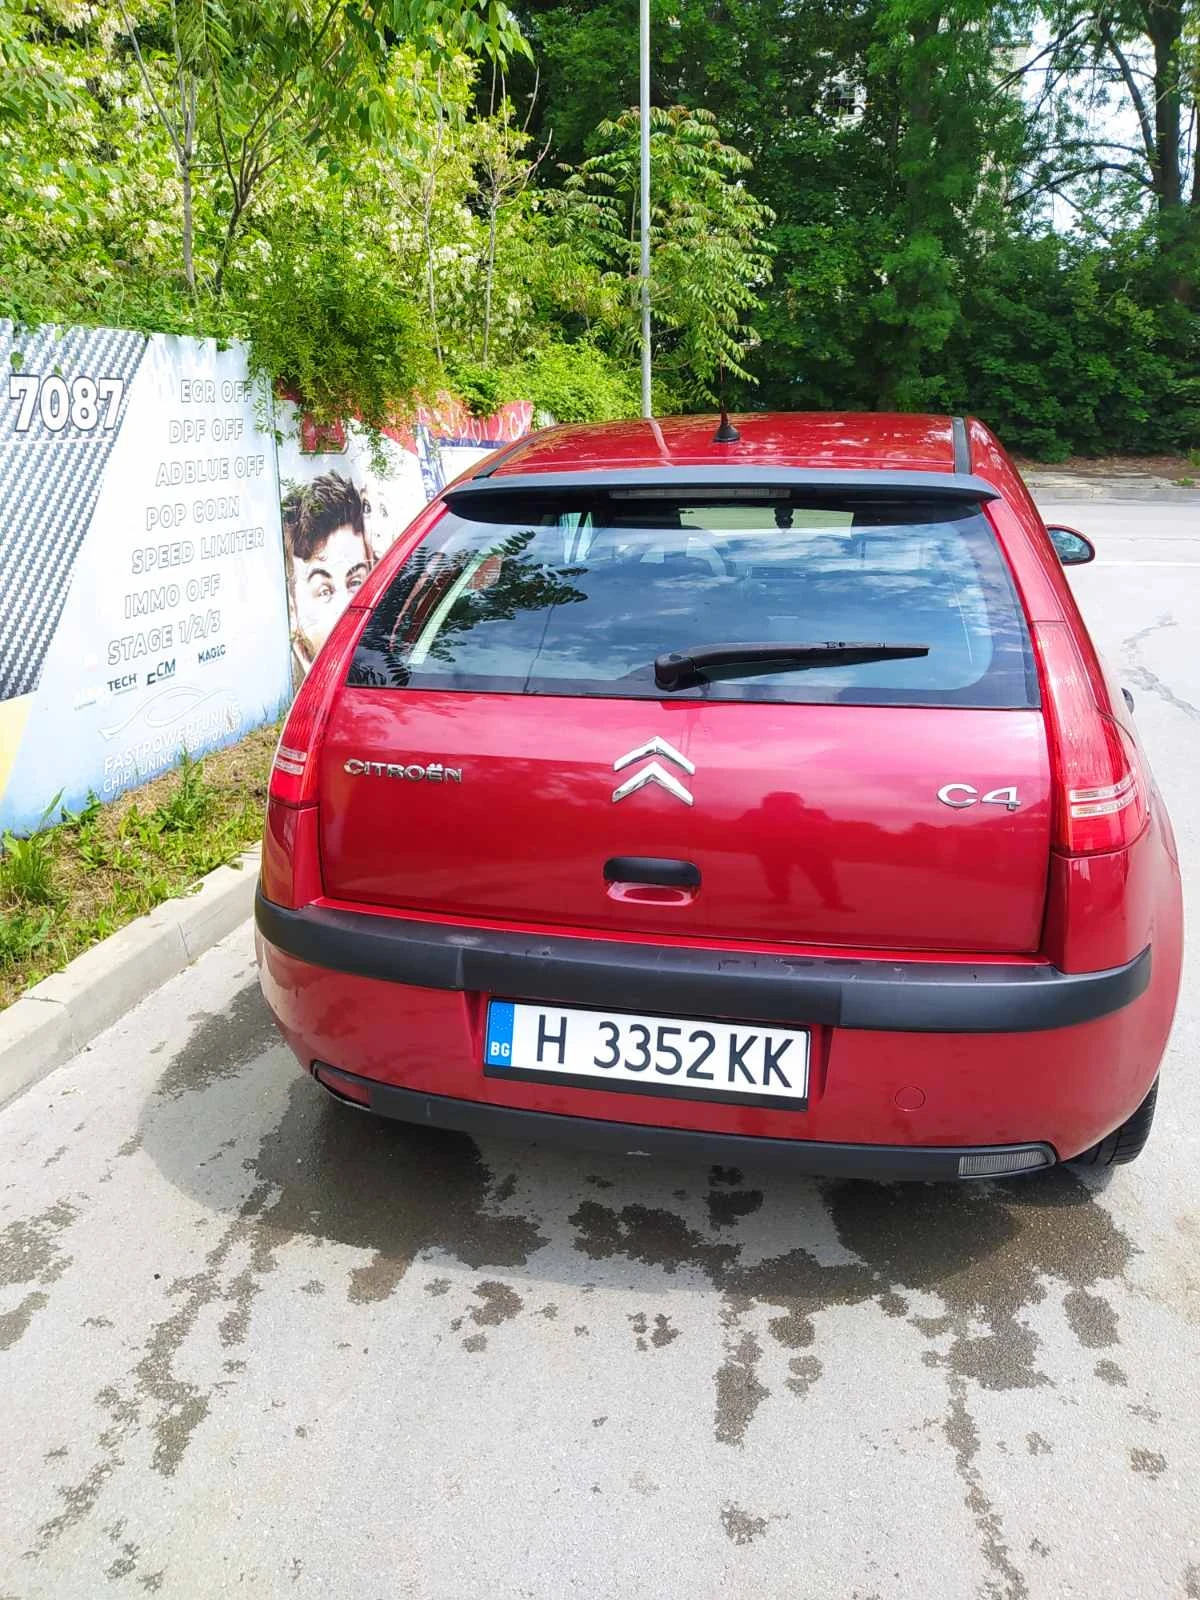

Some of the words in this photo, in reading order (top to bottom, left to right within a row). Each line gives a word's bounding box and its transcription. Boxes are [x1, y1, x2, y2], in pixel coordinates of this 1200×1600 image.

[9, 374, 124, 433] 7087
[180, 379, 215, 403] EGR
[221, 380, 252, 403] OFF
[169, 419, 205, 443] DPF
[211, 418, 244, 441] OFF
[155, 457, 230, 487] ADBLUE
[234, 455, 265, 479] OFF
[146, 504, 186, 531] POP
[192, 496, 240, 522] CORN
[131, 540, 195, 574] SPEED
[200, 526, 265, 560] LIMITER
[124, 584, 180, 619] IMMO
[186, 573, 221, 602] OFF
[107, 624, 173, 666] STAGE
[178, 608, 221, 644] 1/2/3
[107, 672, 138, 692] TECH
[343, 758, 463, 783] CITROËN
[936, 783, 1021, 811] C4
[490, 1042, 511, 1058] BG
[536, 1014, 568, 1065] H
